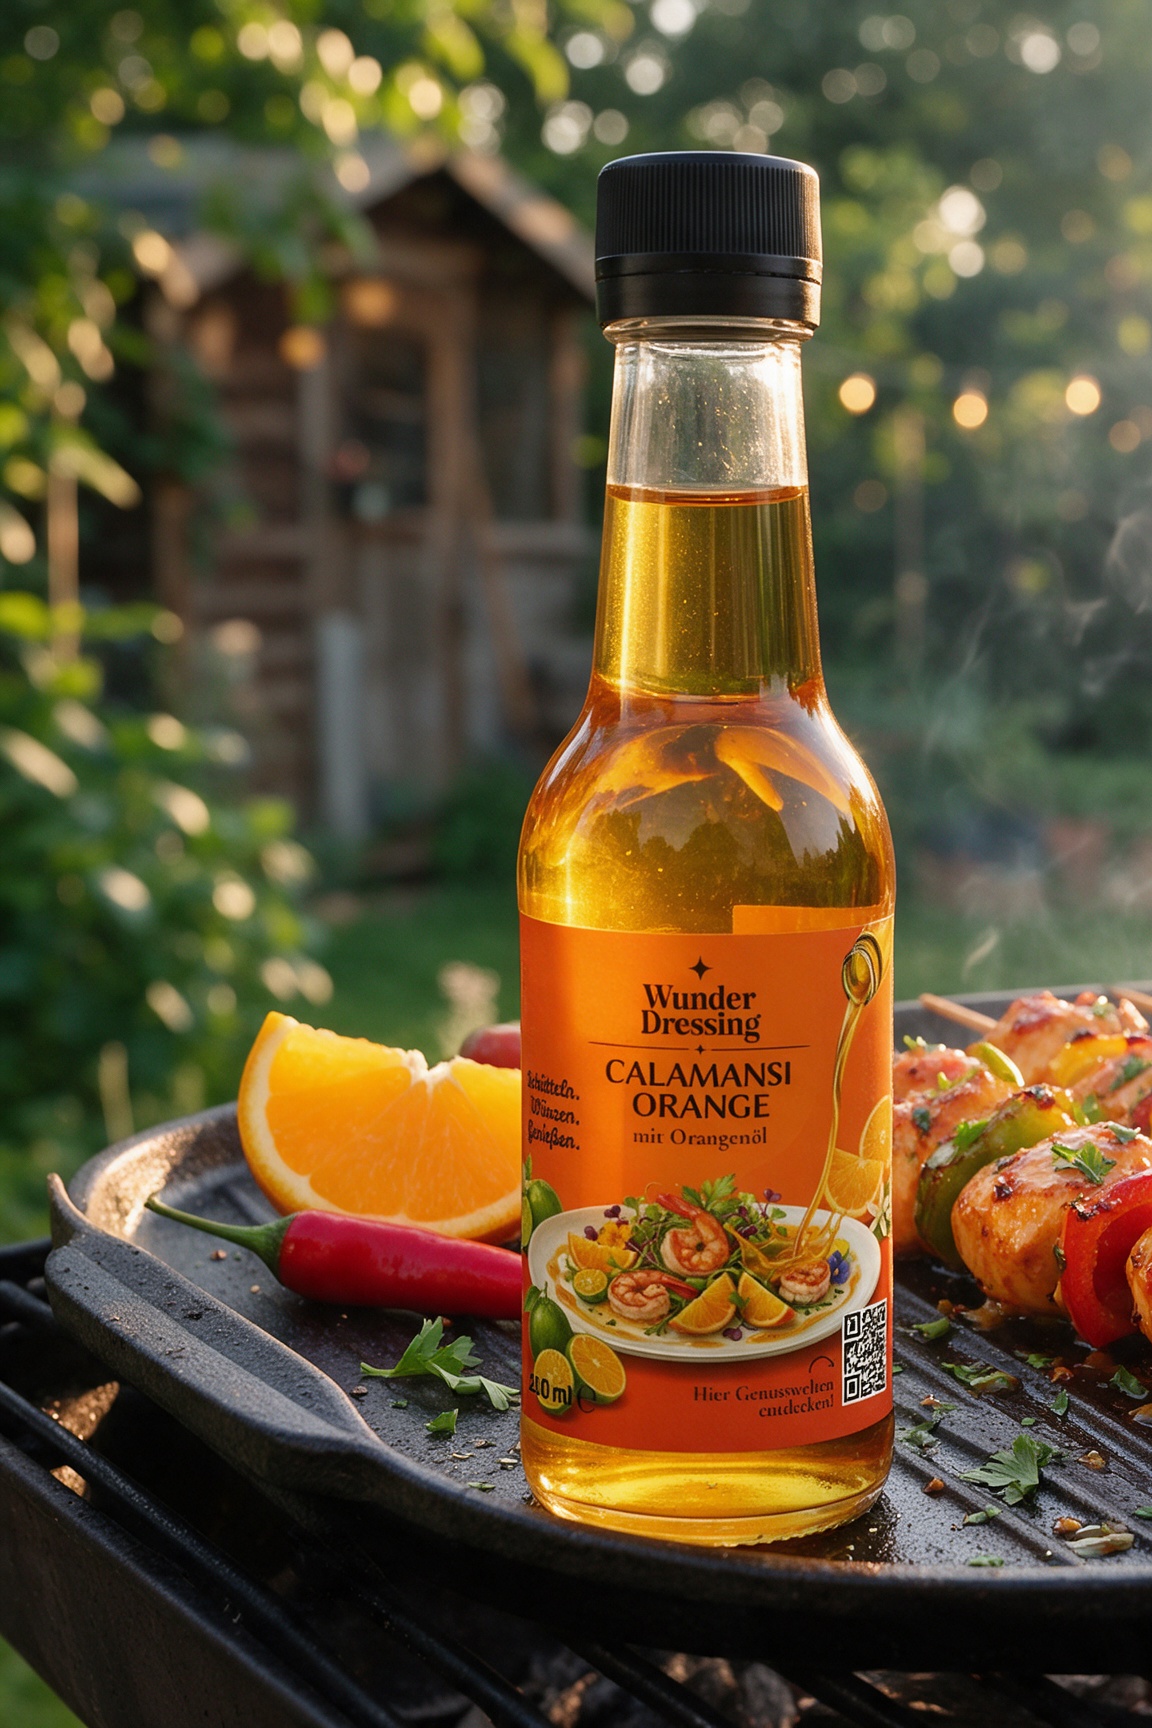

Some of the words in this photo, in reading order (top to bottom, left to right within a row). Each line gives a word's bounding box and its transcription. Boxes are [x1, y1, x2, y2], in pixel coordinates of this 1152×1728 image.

[643, 984, 757, 1010] Wunder
[641, 1009, 761, 1043] Dressing
[605, 1059, 791, 1088] CALAMANSI
[632, 1092, 770, 1119] ORANGE
[633, 1128, 664, 1145] mit
[670, 1127, 767, 1151] Orangenöl
[552, 1385, 573, 1406] ml
[693, 1386, 731, 1401] Hier
[735, 1379, 834, 1401] Genusswelten
[758, 1394, 834, 1417] entdecken!
